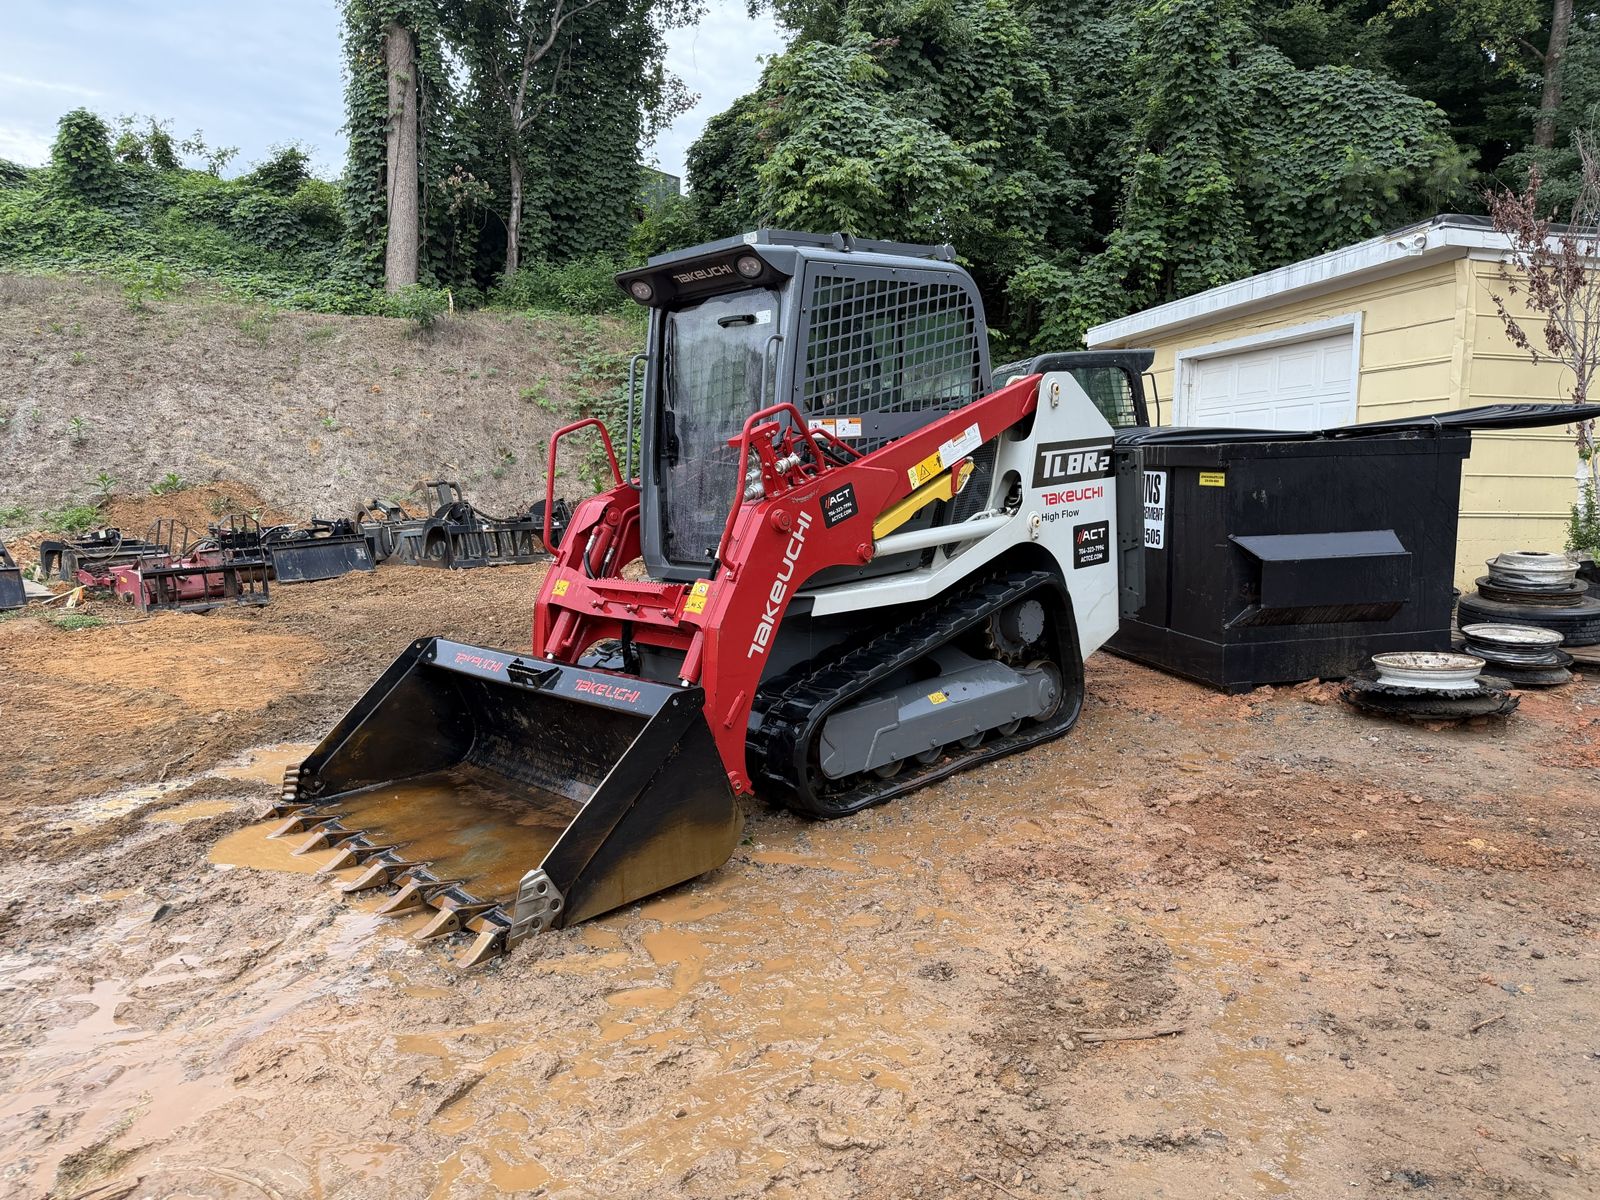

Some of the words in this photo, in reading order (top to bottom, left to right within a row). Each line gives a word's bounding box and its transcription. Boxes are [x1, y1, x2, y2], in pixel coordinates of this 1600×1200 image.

[1041, 444, 1112, 479] TL8R2
[1144, 473, 1161, 504] NS
[830, 488, 850, 506] ACT
[1041, 510, 1059, 523] High
[1061, 508, 1080, 519] Flow
[1082, 527, 1106, 542] ACT
[1080, 553, 1103, 563] ACTCE.COM
